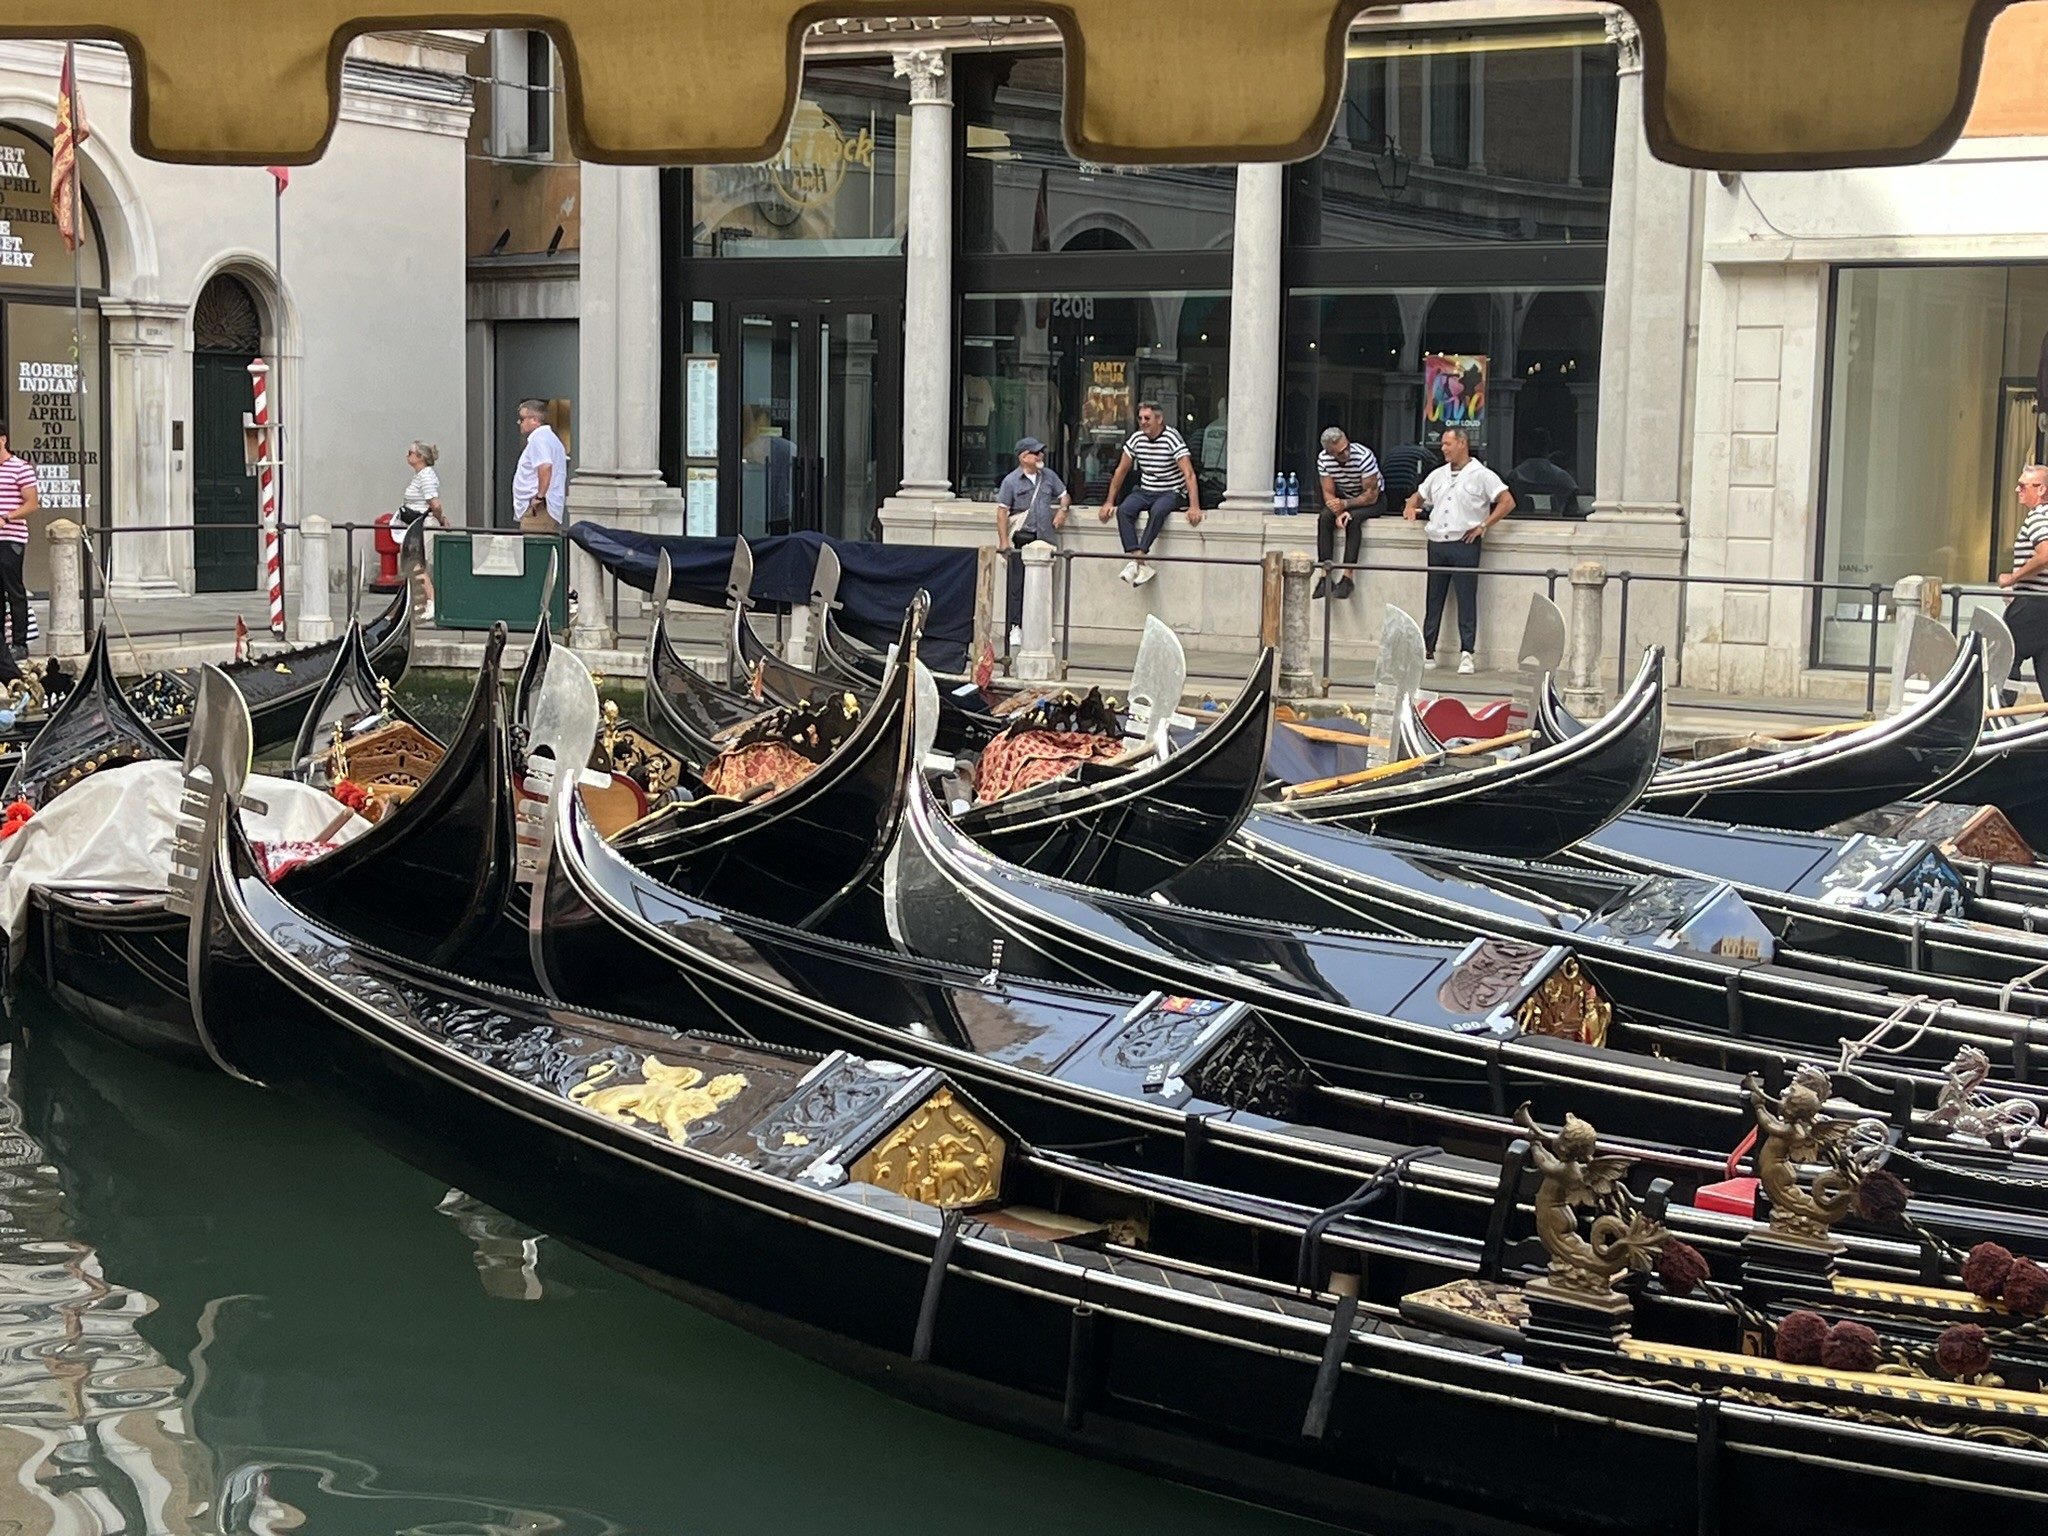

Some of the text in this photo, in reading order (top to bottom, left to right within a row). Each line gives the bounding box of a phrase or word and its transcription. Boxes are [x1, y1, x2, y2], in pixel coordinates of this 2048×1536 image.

[0, 207, 58, 225] EMBE
[0, 251, 35, 267] ERY
[1093, 362, 1126, 373] PARTY
[32, 394, 72, 407] 20TH
[28, 407, 77, 421] APRIL
[42, 422, 62, 435] TO
[33, 437, 71, 449] 24TH
[37, 465, 69, 478] THE
[37, 480, 81, 493] WEET
[38, 494, 92, 508] STERY
